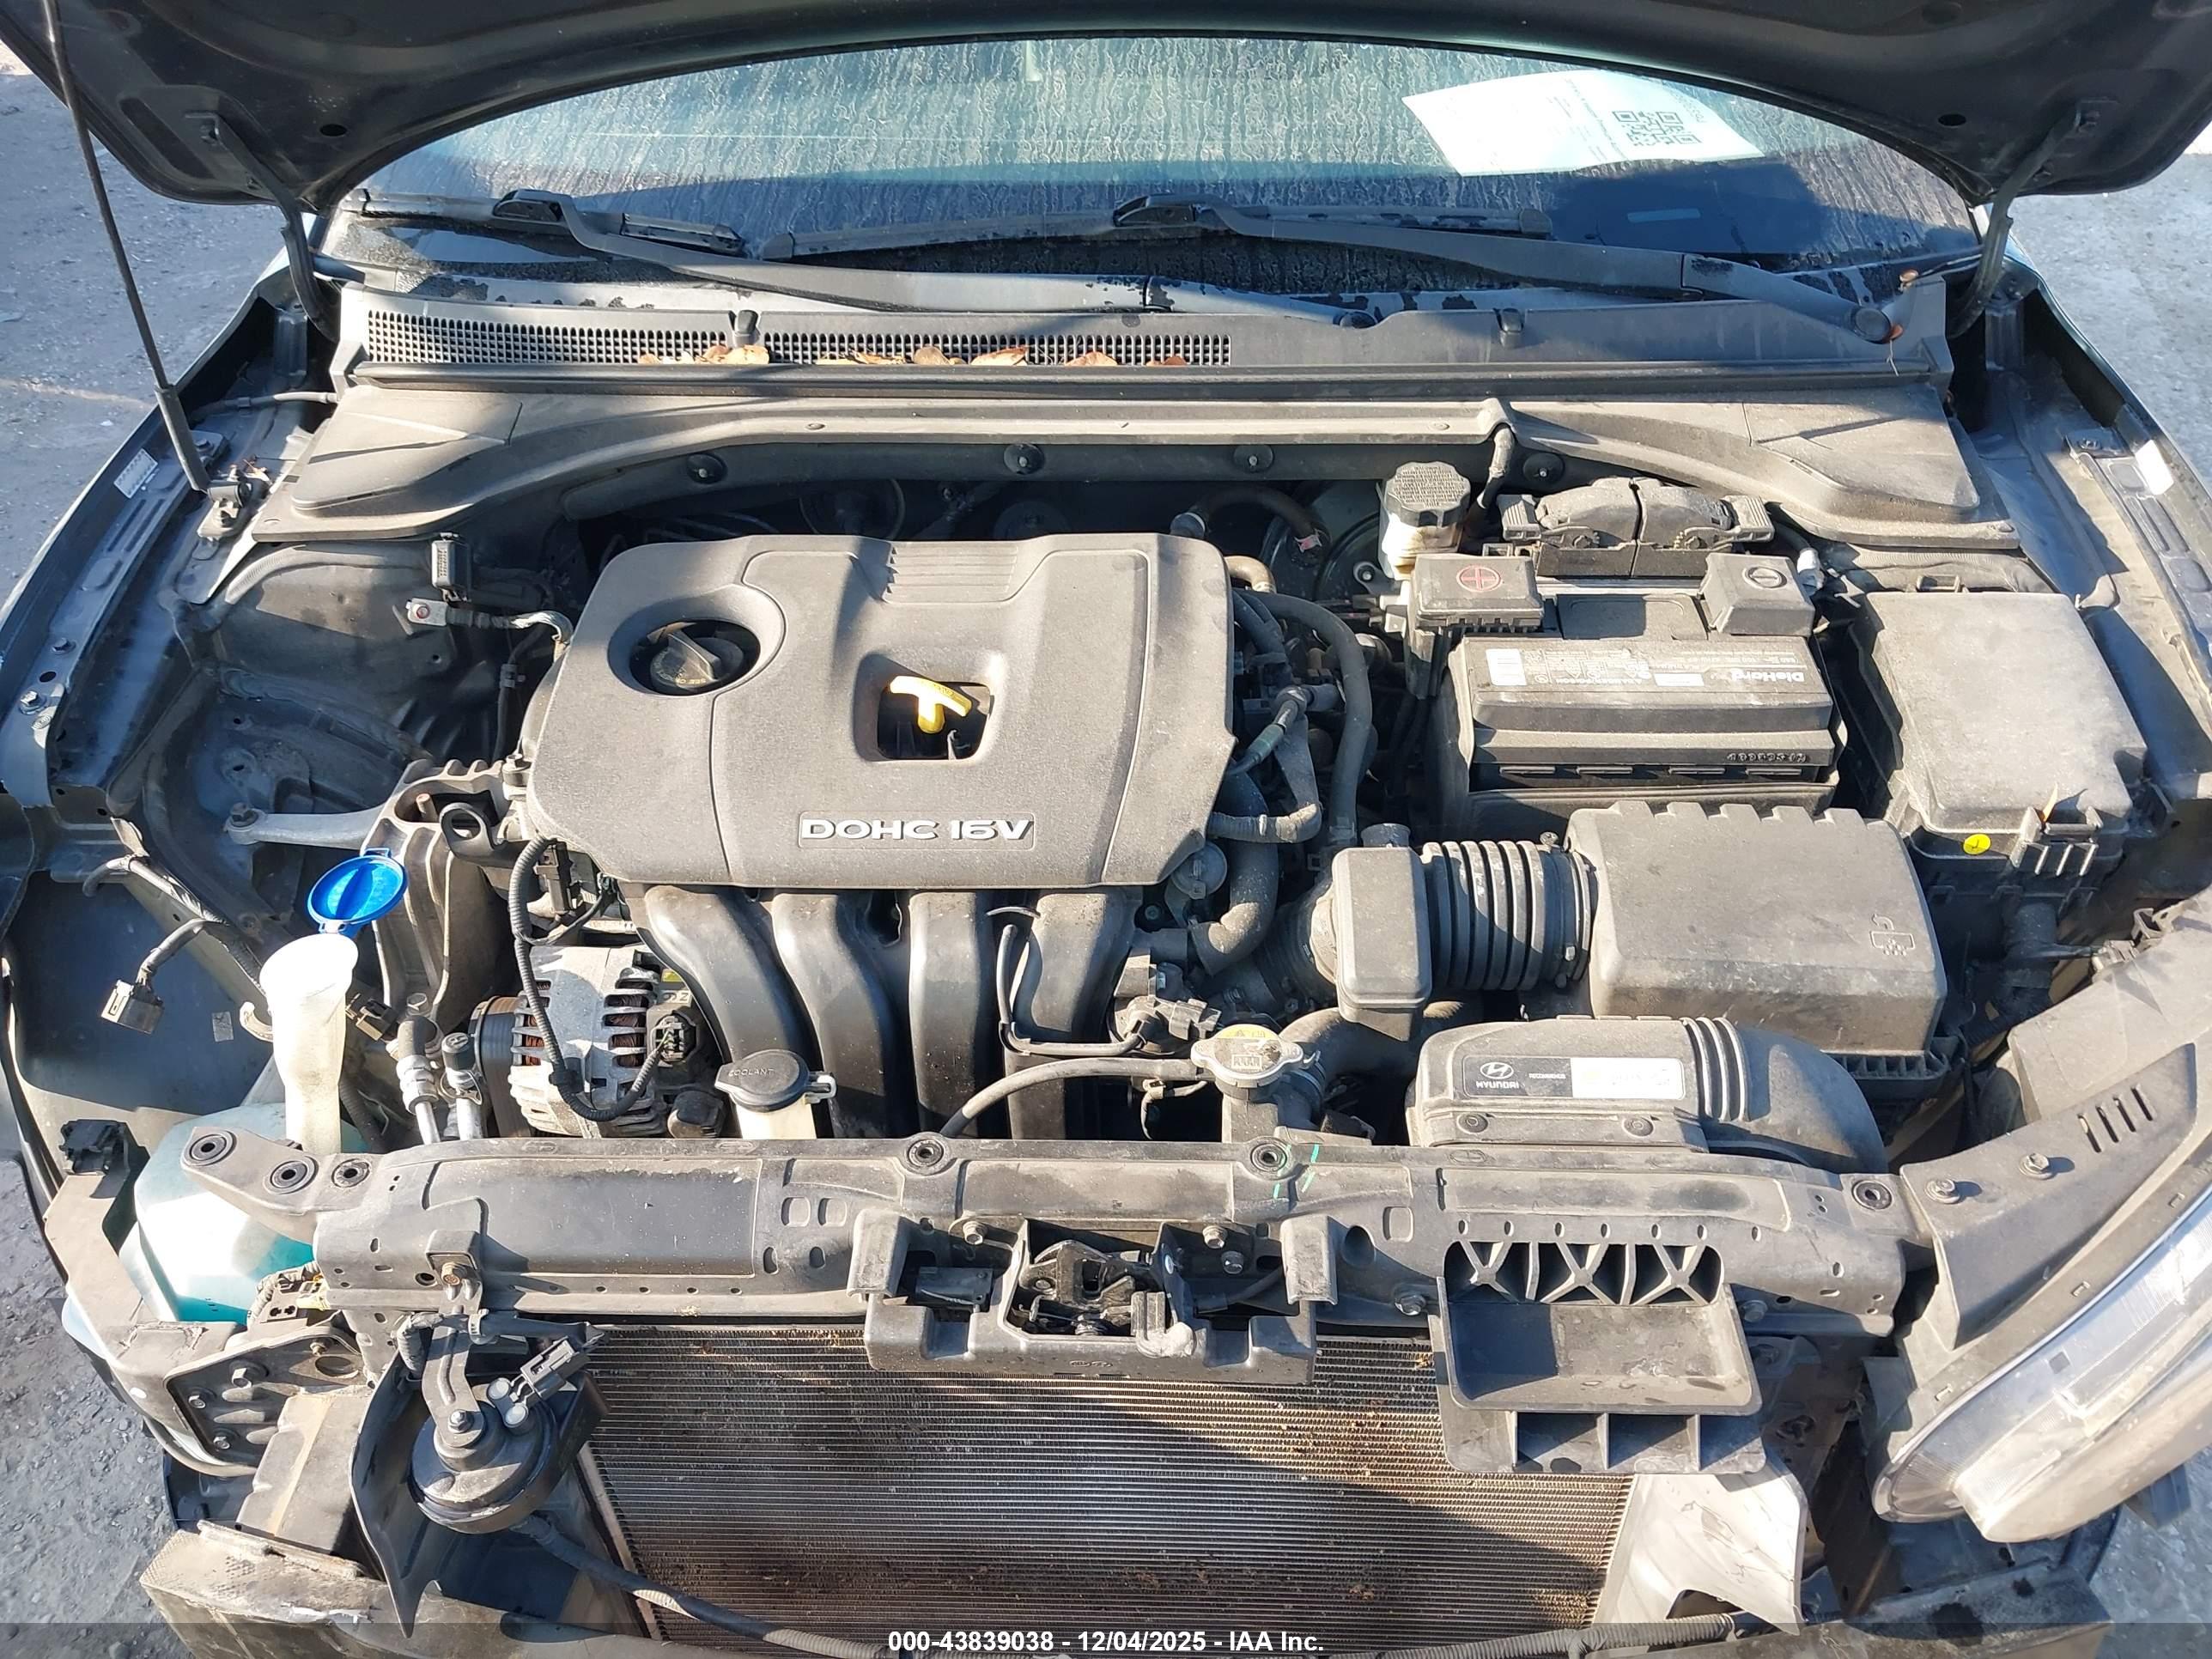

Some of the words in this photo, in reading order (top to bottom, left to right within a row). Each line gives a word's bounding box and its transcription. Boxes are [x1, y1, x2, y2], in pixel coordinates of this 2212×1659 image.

[801, 819, 939, 840] DOHC
[951, 819, 1034, 840] 16V
[729, 1068, 775, 1077] COOLANT
[1476, 1080, 1520, 1089] HYUNDAI
